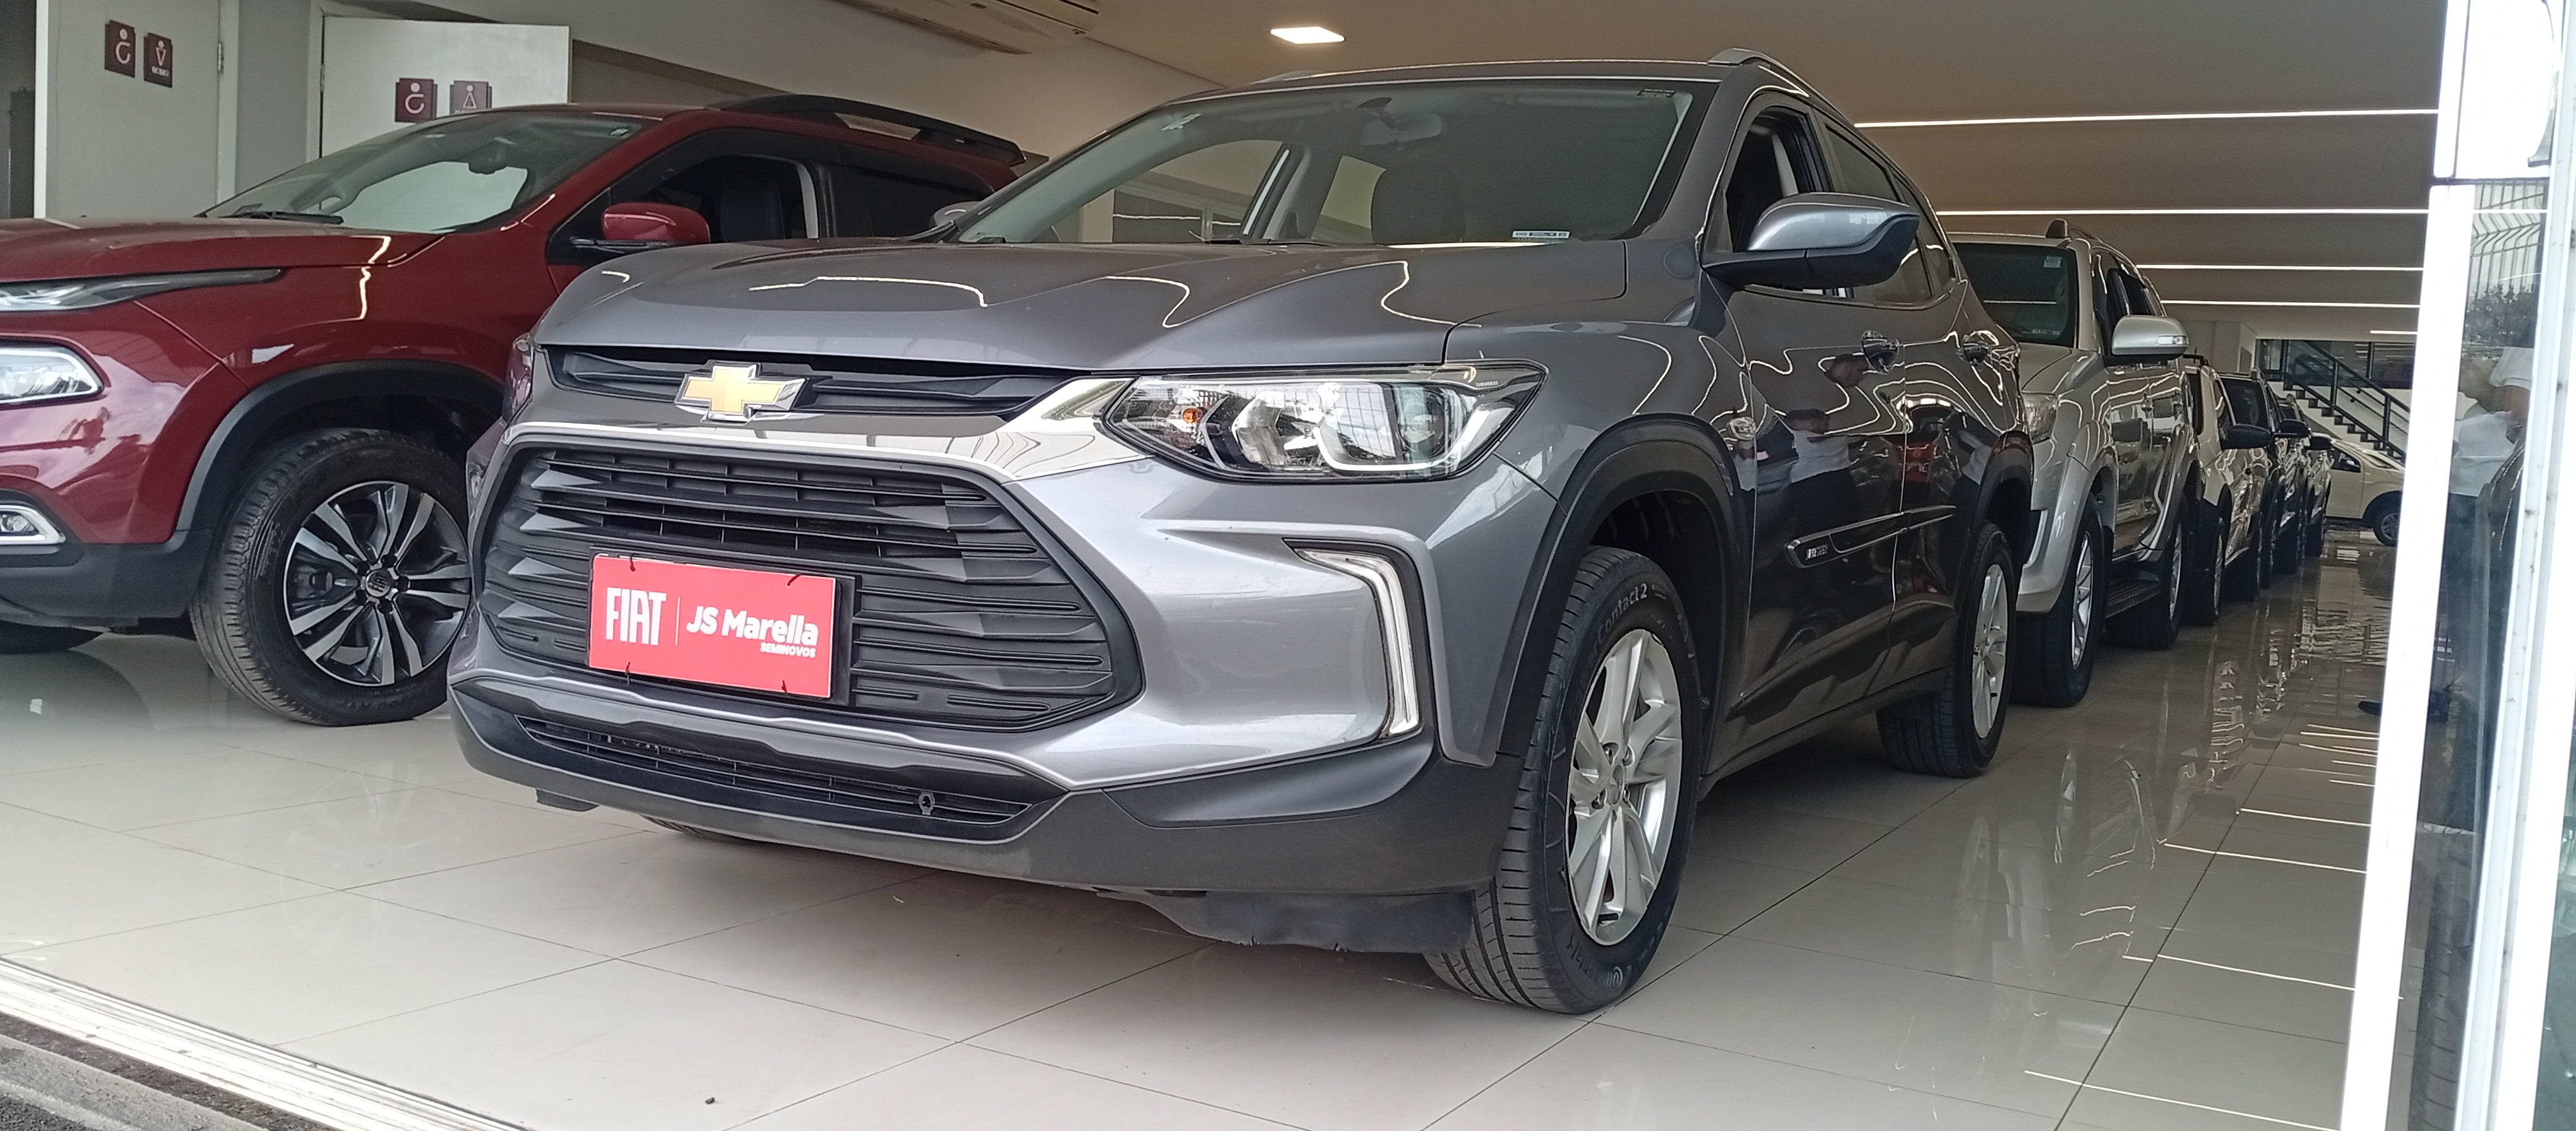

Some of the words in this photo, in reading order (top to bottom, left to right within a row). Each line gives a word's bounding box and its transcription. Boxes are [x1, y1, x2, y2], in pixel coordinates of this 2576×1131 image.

[605, 588, 667, 645] FIAT
[686, 606, 719, 634] JS
[721, 608, 819, 646] Marella
[760, 642, 816, 658] SEMINOVOS
